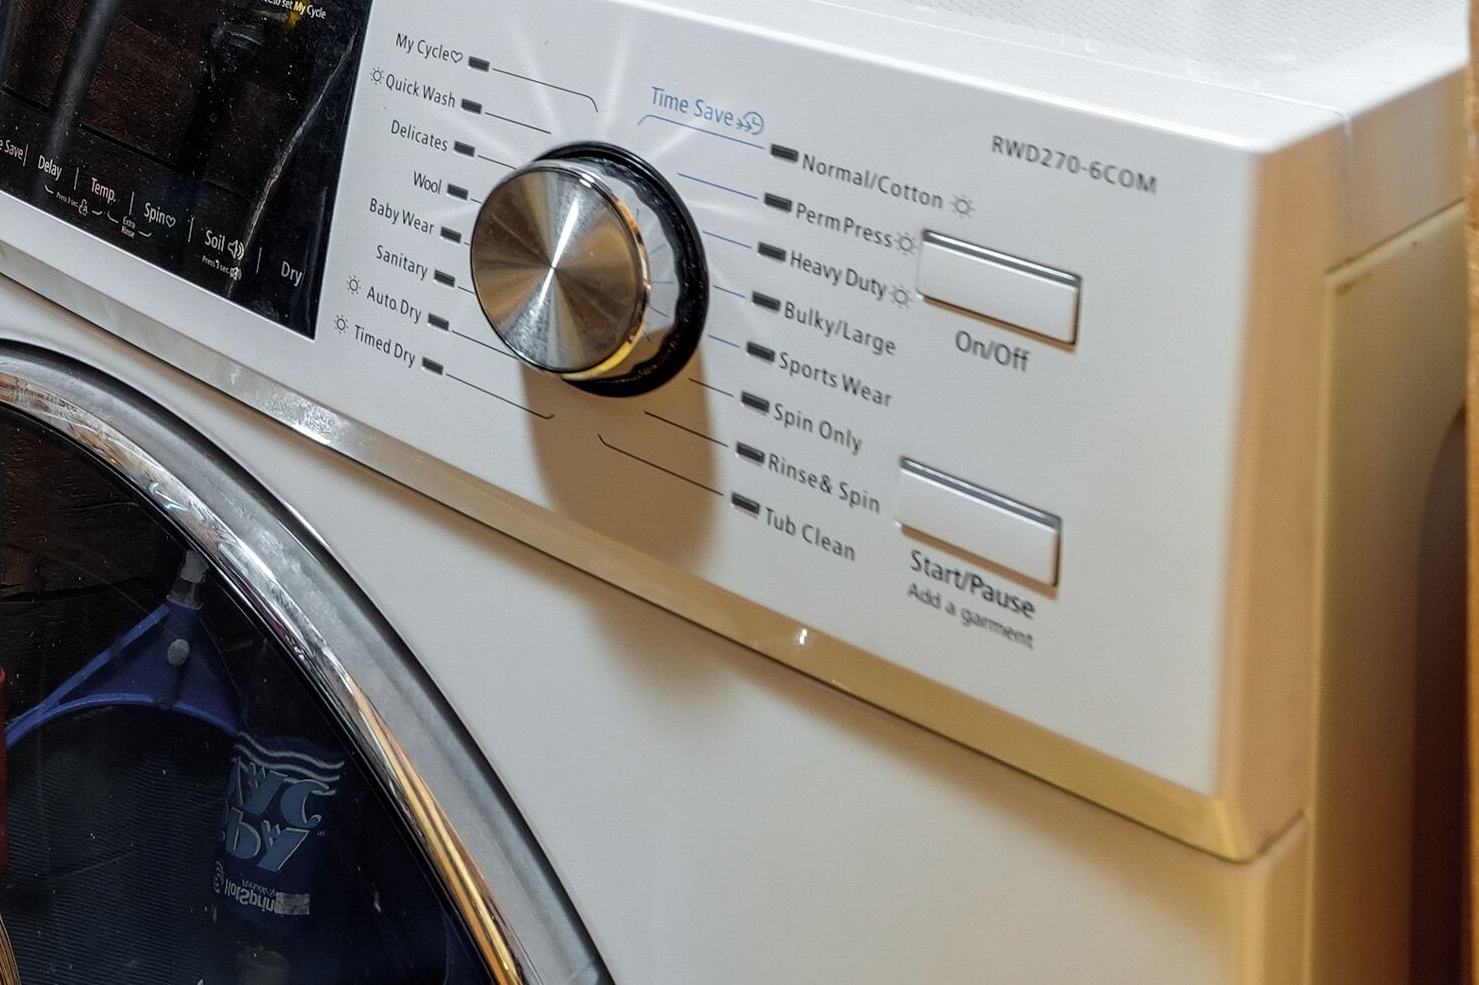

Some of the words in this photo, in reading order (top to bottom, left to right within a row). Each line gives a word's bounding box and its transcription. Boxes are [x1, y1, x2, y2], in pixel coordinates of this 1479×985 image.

[282, 0, 294, 9] set
[293, 1, 306, 15] My
[306, 5, 326, 19] Cycle
[395, 32, 415, 54] My
[417, 39, 450, 61] Cycle
[385, 73, 420, 97] Quick
[423, 84, 456, 108] Wash
[651, 85, 689, 114] Time
[693, 99, 734, 126] Save
[3, 140, 24, 160] Save
[390, 119, 448, 152] Delicates
[37, 155, 63, 181] Delay
[413, 170, 442, 195] Wool
[802, 153, 943, 209] Normal/Cotton
[991, 134, 1158, 195] RWD270-6COM
[91, 177, 117, 204] Temp.
[122, 217, 136, 229] Extra
[143, 202, 166, 225] Spin
[369, 197, 400, 225] Baby
[401, 209, 434, 234] Wear
[796, 202, 841, 231] Perm
[843, 216, 893, 248] Press
[204, 230, 225, 252] Soil
[201, 255, 215, 269] Press
[280, 261, 303, 287] Dry
[376, 244, 428, 281] Sanitary
[790, 250, 843, 286] Heavy
[845, 268, 888, 301] Duty
[366, 286, 397, 310] Auto
[400, 299, 422, 324] Dry
[355, 324, 392, 354] Timed
[394, 343, 416, 368] Dry
[784, 301, 896, 356] Bulky/Large
[955, 330, 1031, 373] On/Off
[779, 352, 838, 388] Sports
[842, 373, 893, 407] Wear
[773, 402, 814, 433] Spin
[819, 420, 863, 456] Only
[839, 481, 881, 514] Spin
[765, 507, 797, 537] Tub
[802, 523, 856, 562] Clean
[910, 549, 1036, 621] Start/Pause
[907, 582, 942, 610] Add
[945, 601, 956, 616] a
[960, 608, 1035, 651] garment
